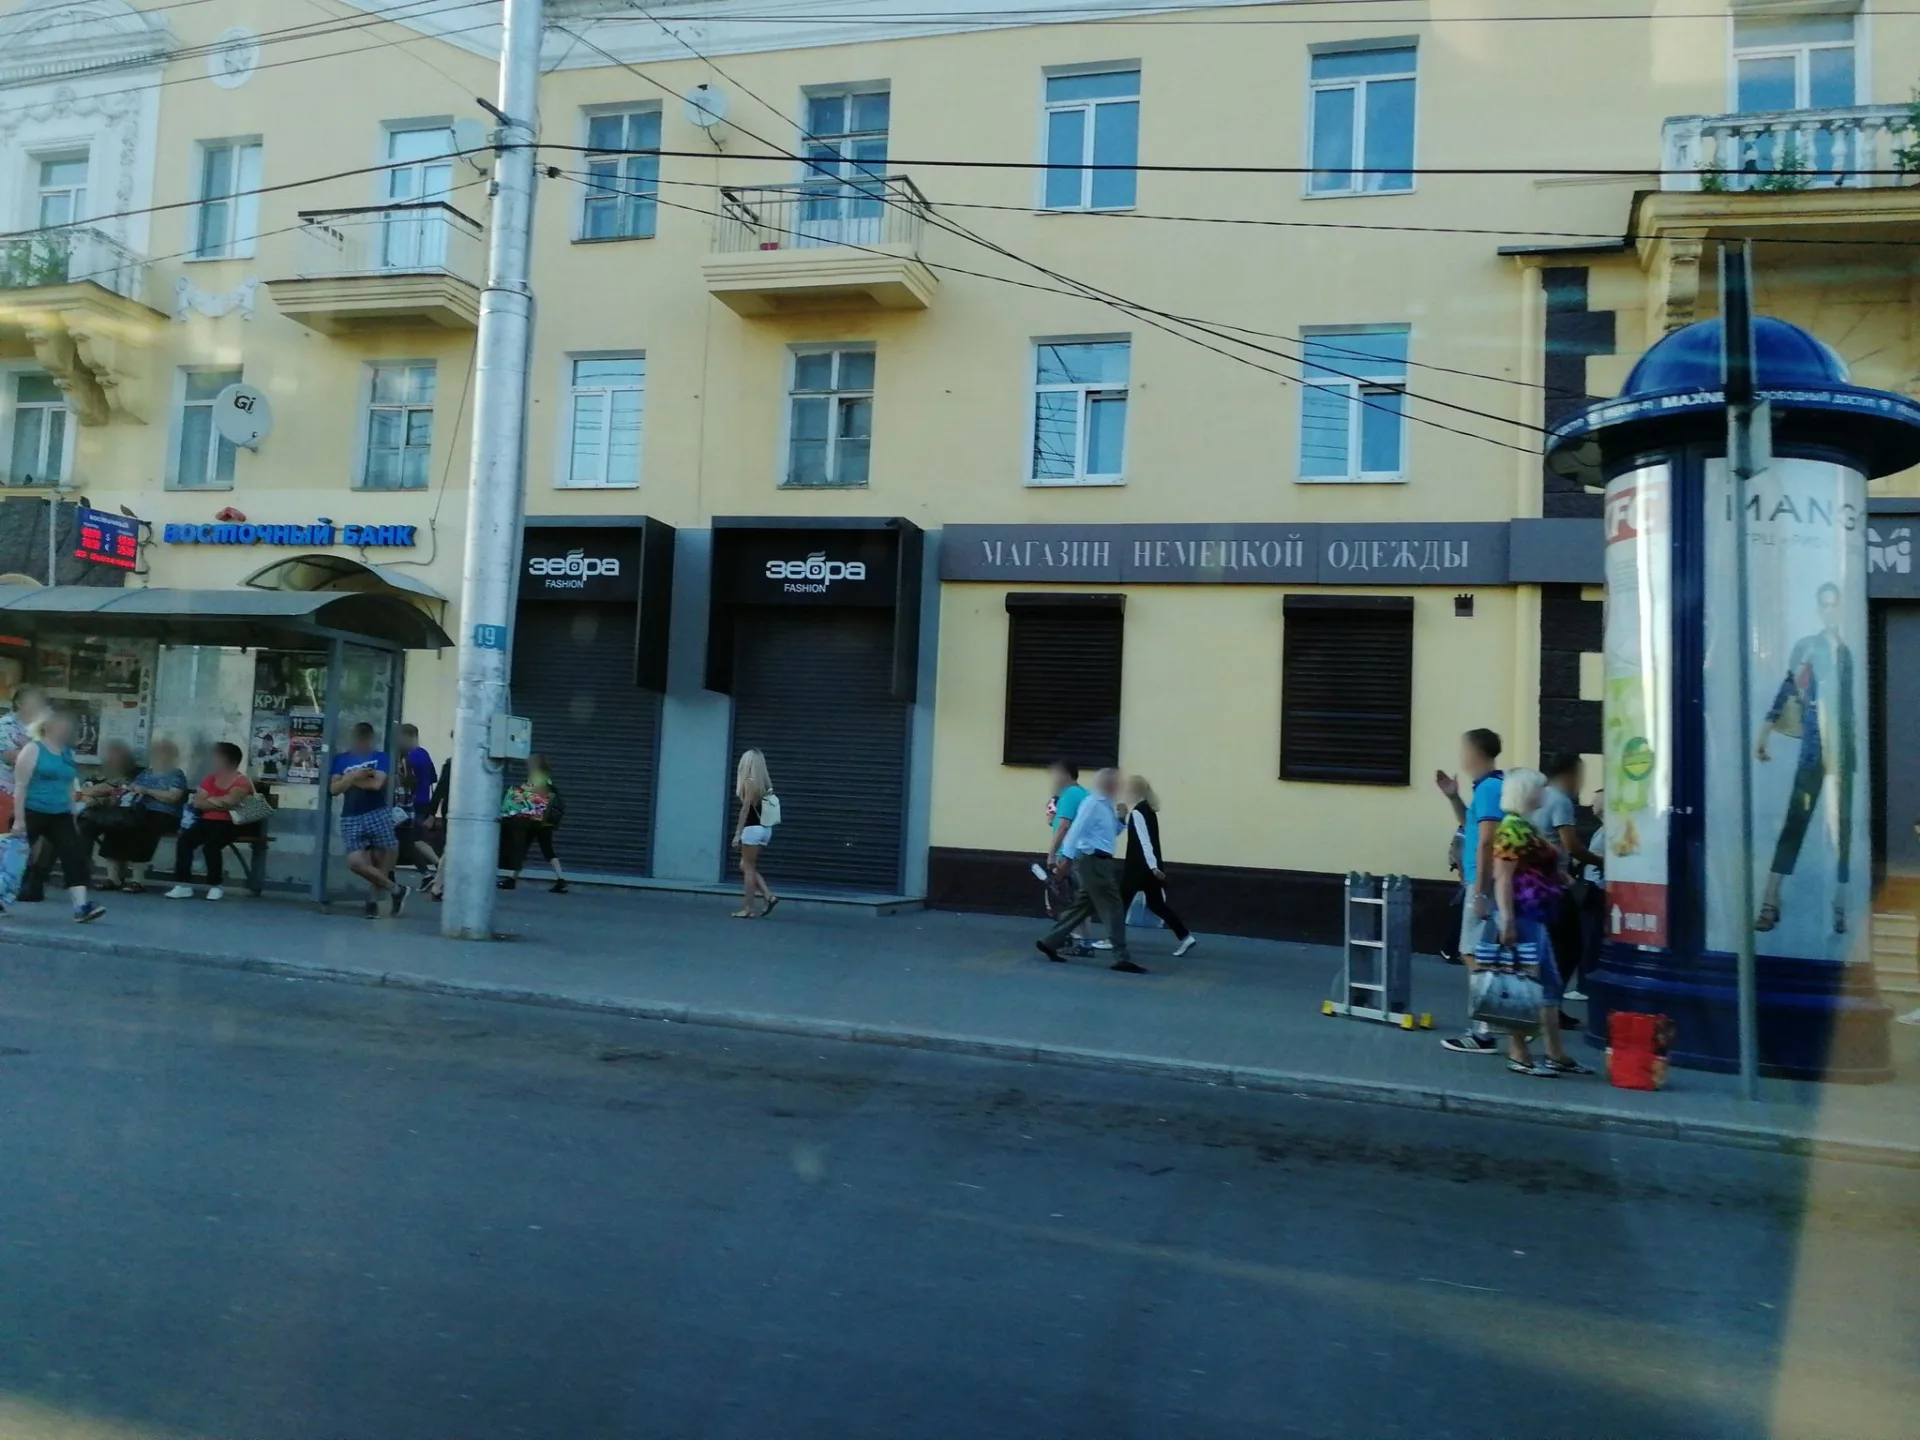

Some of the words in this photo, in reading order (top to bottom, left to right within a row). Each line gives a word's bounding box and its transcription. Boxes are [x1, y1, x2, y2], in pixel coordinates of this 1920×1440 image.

[234, 395, 256, 411] Gi
[163, 517, 337, 547] ВОСТОЧНЫЙ
[343, 524, 417, 548] БАНК
[982, 540, 1112, 567] МАГАЗИН
[1133, 533, 1304, 571] НЕМЕЦКОЙ
[1328, 540, 1469, 571] ОДЕЖДЫ
[545, 579, 584, 589] FASHION
[784, 583, 827, 593] FASHION
[478, 627, 496, 646] 19
[254, 693, 290, 709] КРУГ
